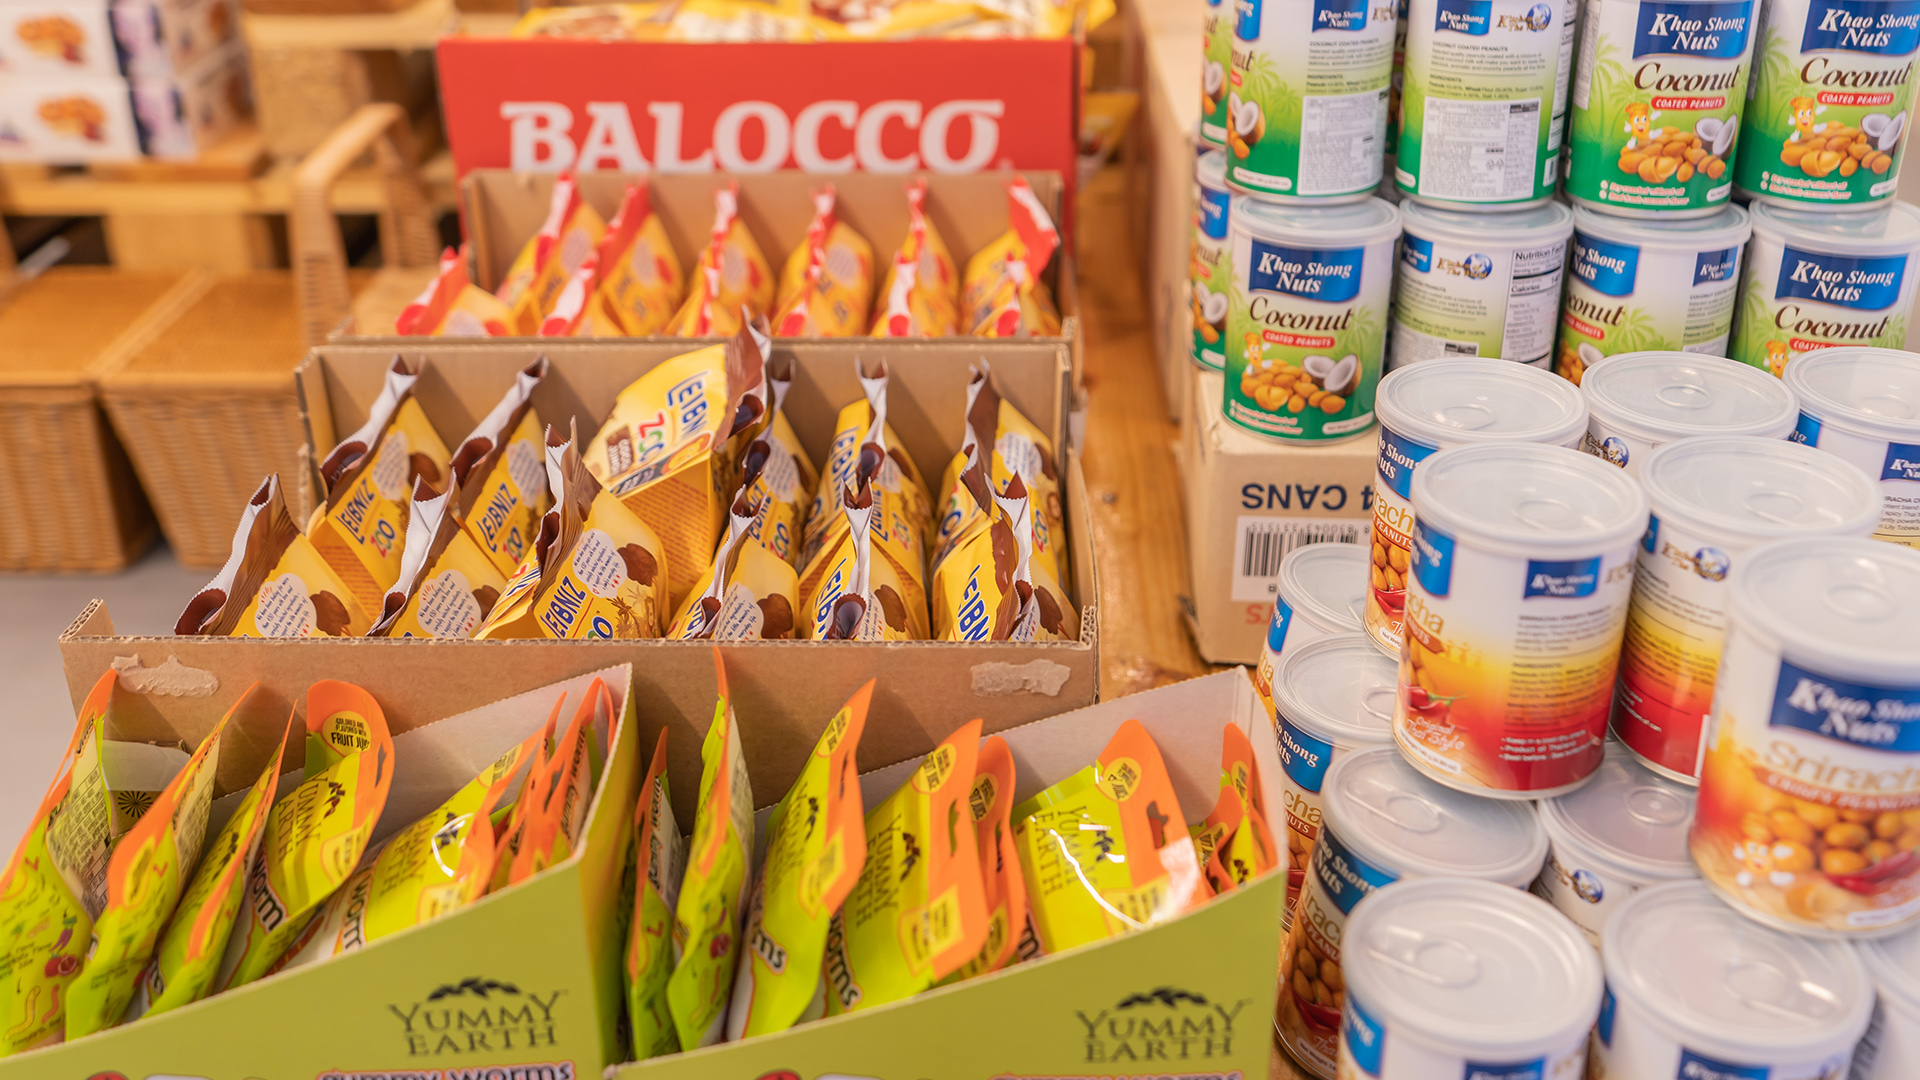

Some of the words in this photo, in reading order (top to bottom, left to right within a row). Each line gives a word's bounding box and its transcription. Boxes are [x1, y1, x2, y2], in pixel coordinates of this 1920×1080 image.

[1440, 10, 1460, 22] Khao
[1449, 20, 1469, 30] Nuts
[1649, 13, 1702, 35] Khao
[1705, 16, 1746, 32] Shong
[1819, 8, 1874, 32] Khao
[1876, 13, 1920, 30] Shong
[1672, 31, 1720, 51] Nuts
[1841, 29, 1890, 48] Nuts
[1634, 62, 1741, 91] Coconut
[1801, 57, 1913, 88] Coconut
[1656, 97, 1688, 108] COATED
[1691, 96, 1724, 108] PEANUTS
[1821, 93, 1854, 105] COATED
[1857, 92, 1892, 106] PEANUTS
[501, 100, 1005, 175] BALOCCO
[1258, 252, 1302, 275] Khao
[1305, 262, 1353, 279] Shong
[1516, 249, 1550, 260] Nutrition
[1586, 248, 1626, 274] Shong
[1276, 272, 1322, 293] Nuts
[1790, 260, 1844, 284] Khao
[1846, 270, 1896, 287] Shong
[1511, 284, 1540, 292] Calories
[1811, 280, 1863, 302] Nuts
[1250, 296, 1354, 331] Coconut
[1774, 304, 1890, 340] Coconut
[1265, 331, 1294, 344] COATED
[1296, 333, 1332, 346] PEANUTS
[1242, 483, 1347, 510] CANS
[336, 478, 374, 545] LEIBNIZ
[476, 482, 517, 553] LEIBNIZ
[371, 520, 396, 559] ZOO
[503, 527, 524, 565] ZOO
[1530, 573, 1566, 588] Khao
[1568, 574, 1595, 586] Shong
[1545, 583, 1576, 596] Nuts
[540, 576, 586, 639] LEIBNIZ
[730, 603, 743, 619] ingredients
[738, 610, 749, 622] moments
[738, 623, 752, 638] everyday
[1786, 676, 1870, 720] Khao
[1407, 718, 1426, 740] Thai
[1428, 732, 1466, 752] Style
[1416, 716, 1456, 734] Original
[1820, 712, 1898, 744] Nuts
[331, 732, 354, 747] FRUIT
[1276, 740, 1292, 765] uts
[1282, 730, 1319, 768] Shong
[1523, 753, 1546, 761] before
[299, 768, 330, 848] YUMMY
[278, 799, 294, 863] ARTH
[648, 837, 662, 892] gummy
[877, 813, 901, 912] YUMMY
[1034, 812, 1064, 896] EARTH
[388, 990, 561, 1032] YUMMY
[1075, 998, 1250, 1040] YUMMY
[407, 1026, 557, 1056] EARTH
[1084, 1036, 1234, 1064] EARTH
